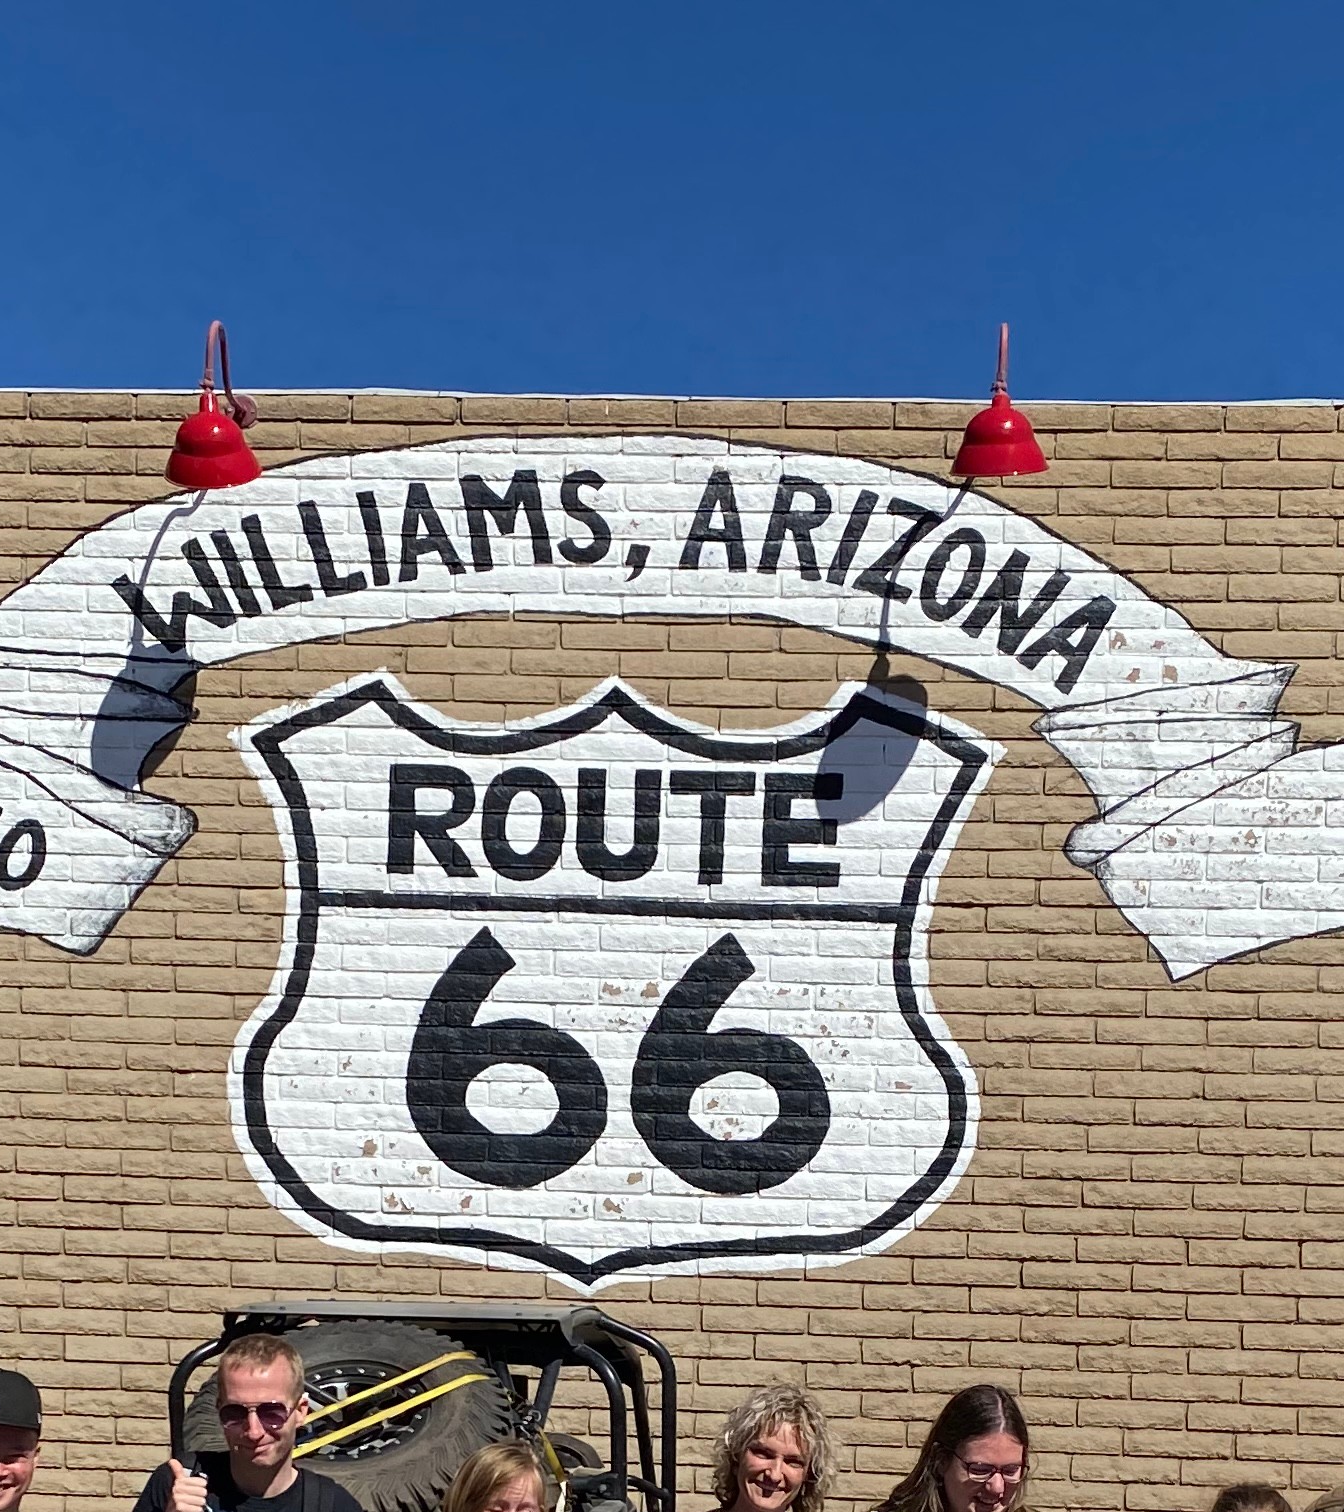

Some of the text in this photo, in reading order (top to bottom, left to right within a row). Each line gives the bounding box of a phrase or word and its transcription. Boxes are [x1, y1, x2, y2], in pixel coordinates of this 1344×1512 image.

[110, 468, 1120, 695] WILLIAMS, ARIZONA
[387, 763, 843, 889] ROUTE
[404, 924, 833, 1196] 66
